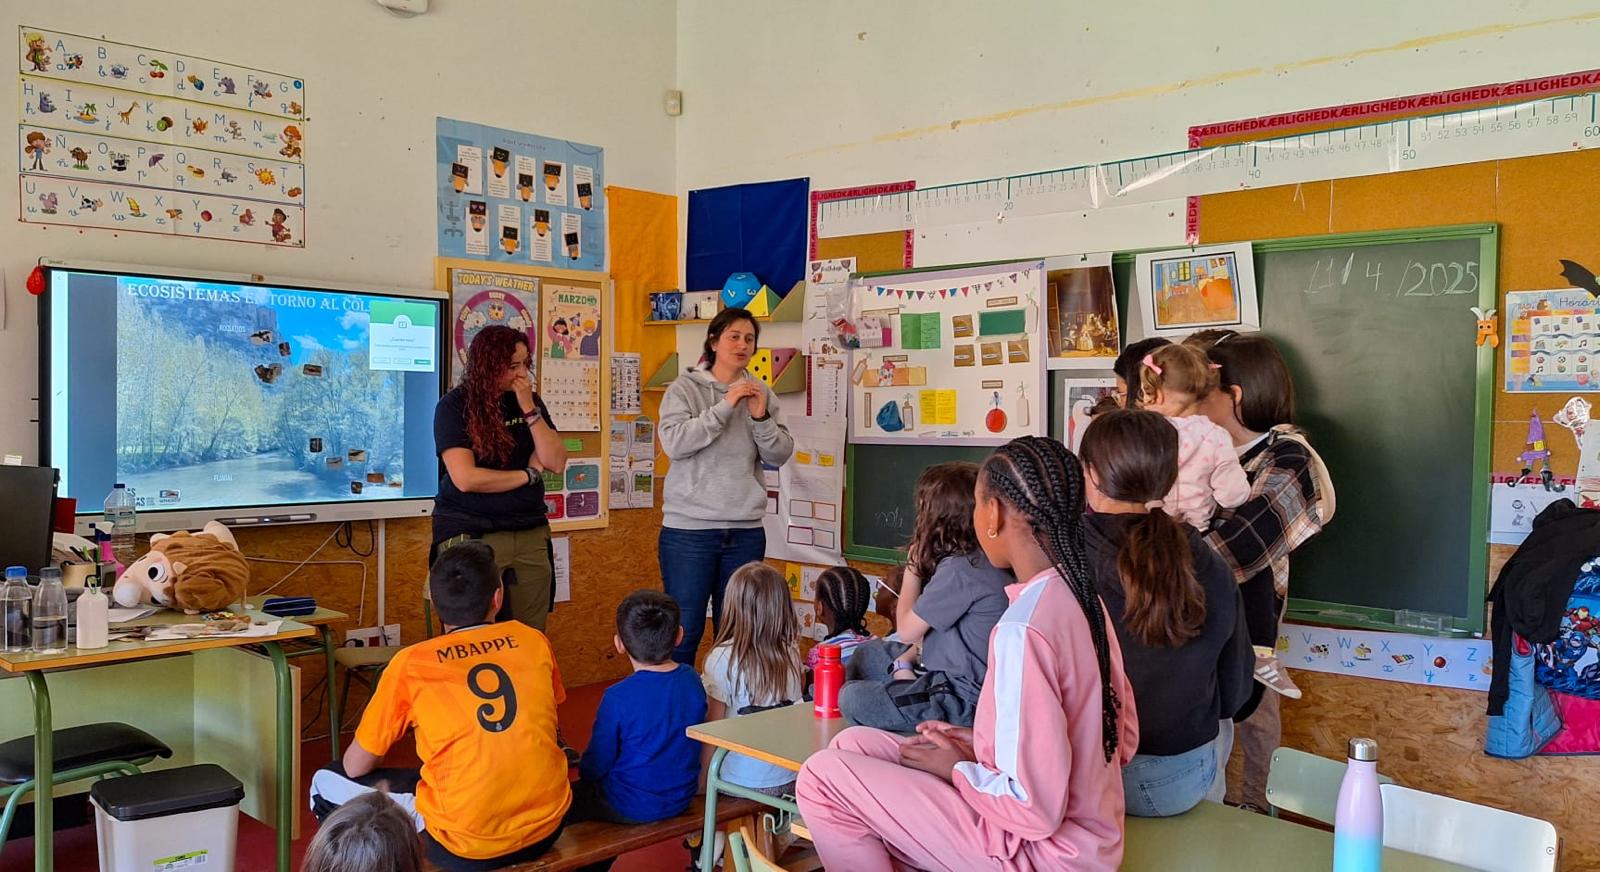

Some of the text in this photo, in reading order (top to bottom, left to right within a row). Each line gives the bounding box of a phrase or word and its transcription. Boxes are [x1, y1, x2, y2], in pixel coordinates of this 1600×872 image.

[56, 40, 288, 92] A B C D E F G
[24, 84, 262, 132] H I J K L M N
[56, 135, 287, 178] Ñ O P Q R S T
[1004, 202, 1013, 210] 20
[1248, 169, 1261, 178] 40
[1279, 152, 1290, 160] 42
[1324, 145, 1335, 154] 45
[1339, 143, 1350, 152] 46
[1354, 141, 1366, 149] 47
[1370, 139, 1382, 148] 48
[1402, 150, 1416, 160] 50
[1421, 132, 1432, 141] 51
[1437, 130, 1449, 140] 52
[1455, 128, 1467, 137] 53
[1472, 125, 1485, 135] 54
[1490, 123, 1503, 132] 55
[1508, 120, 1520, 130] 56
[1527, 117, 1540, 127] 57
[1546, 114, 1559, 125] 58
[1564, 112, 1578, 123] 59
[1584, 125, 1600, 137] 60
[26, 182, 240, 215] U V W X Y Z
[128, 283, 240, 303] ECOSISTEMAS
[270, 294, 316, 308] TORNO
[320, 297, 340, 311] AL
[457, 273, 535, 293] TODAY'S WEATHER
[558, 294, 586, 305] MARZO
[1302, 634, 1478, 661] V W X Y Z
[467, 662, 517, 733] 9
